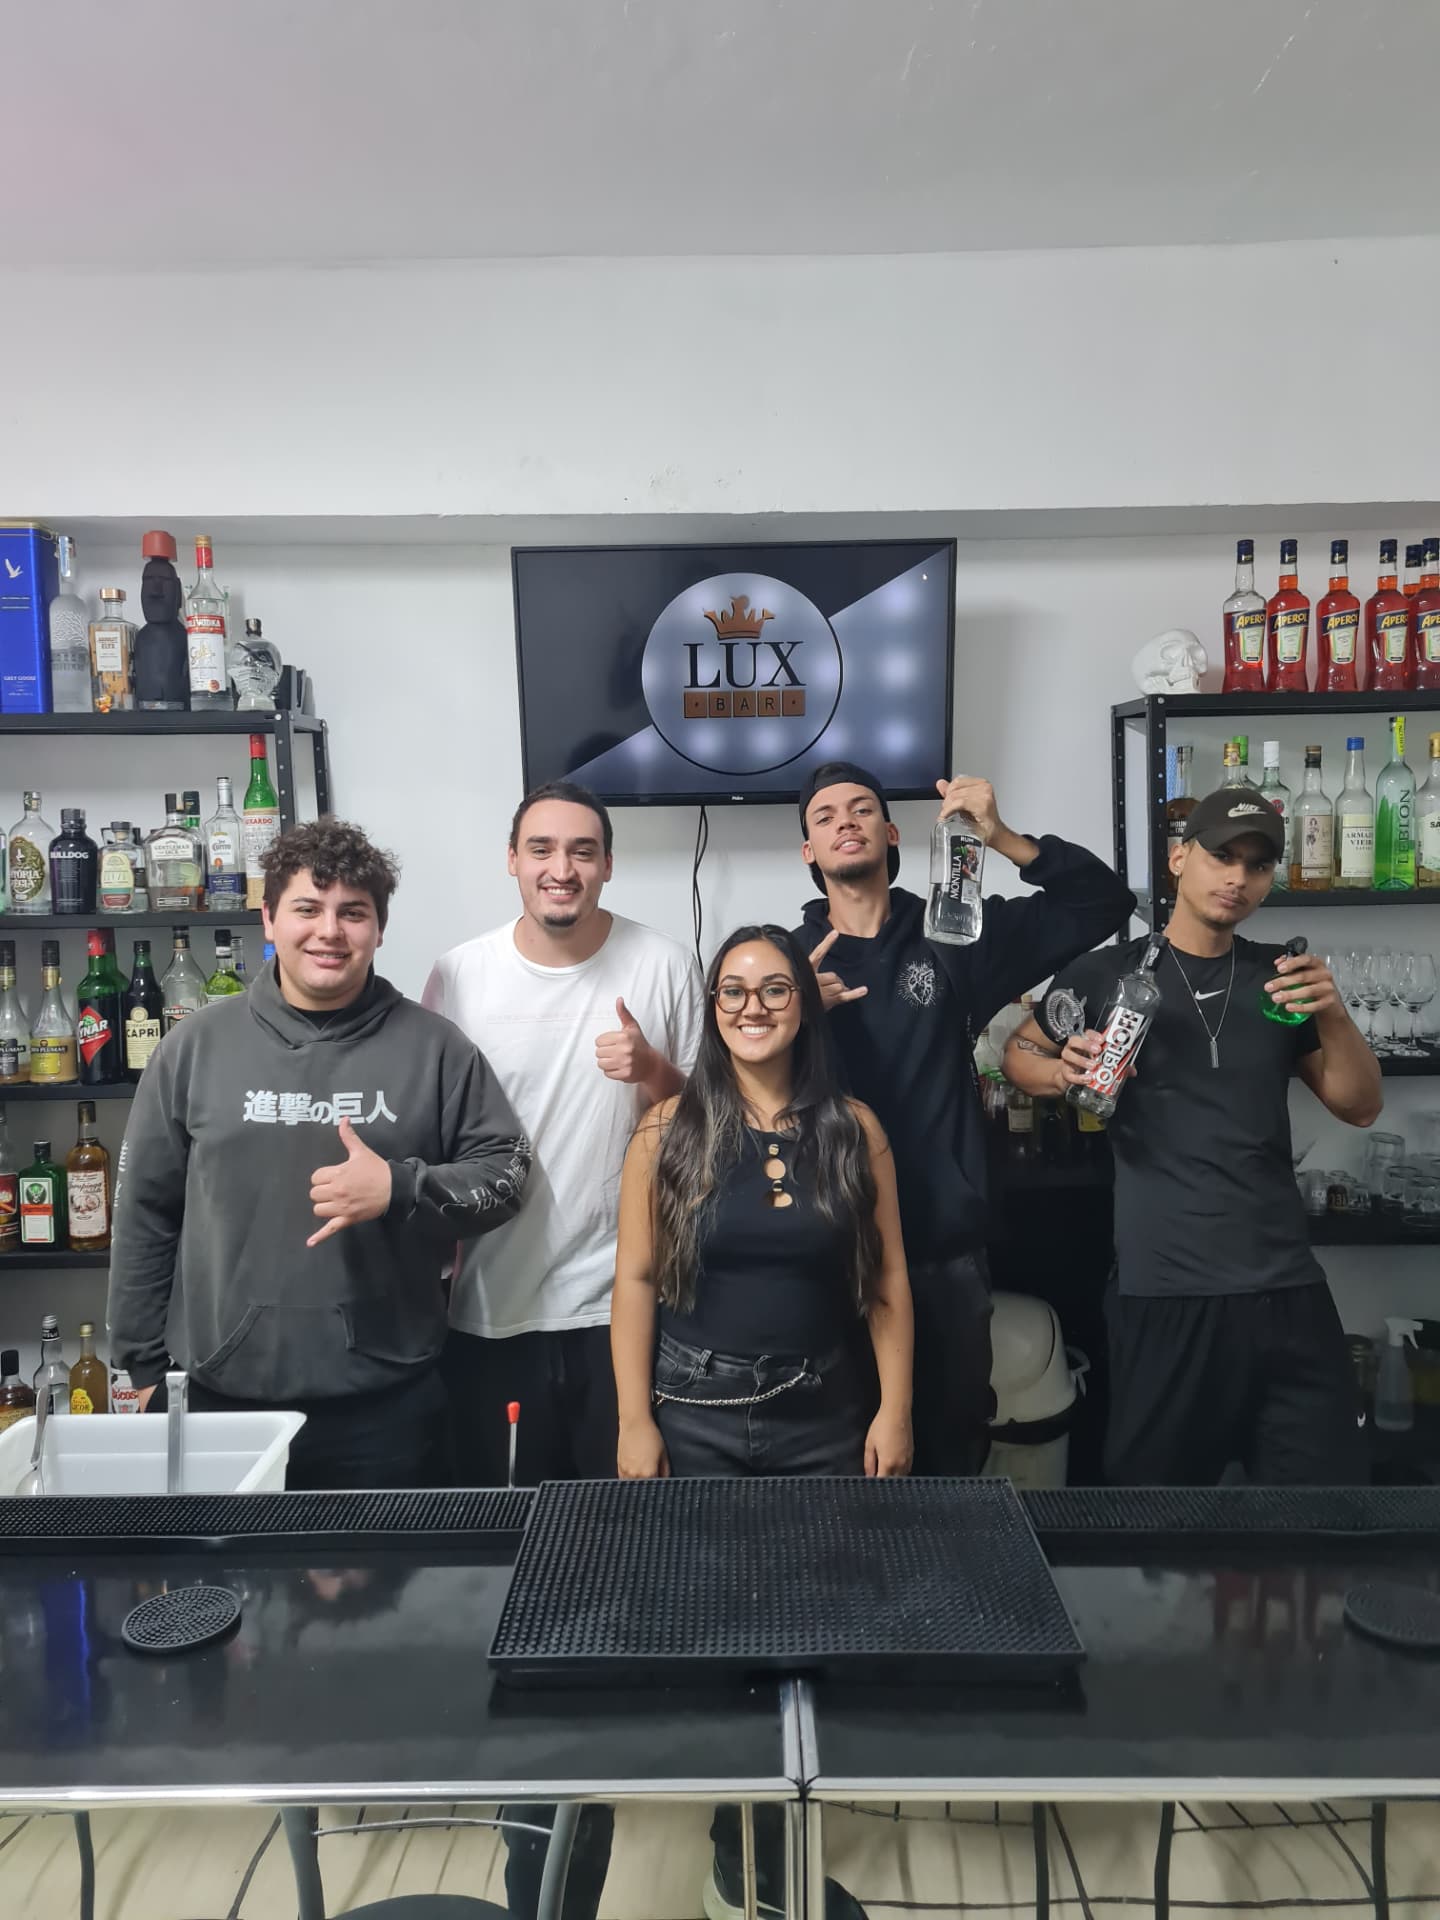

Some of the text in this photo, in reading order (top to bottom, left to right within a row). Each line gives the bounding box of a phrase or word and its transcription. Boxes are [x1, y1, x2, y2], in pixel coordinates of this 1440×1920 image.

[1236, 614, 1265, 629] APERO
[1421, 614, 1440, 629] APE
[683, 641, 807, 688] LUX
[716, 697, 775, 711] BAR
[1237, 803, 1259, 812] NIKE
[50, 851, 89, 859] BULLDOG
[949, 855, 962, 899] MONTILLA
[243, 1089, 398, 1126] 進撃の巨人
